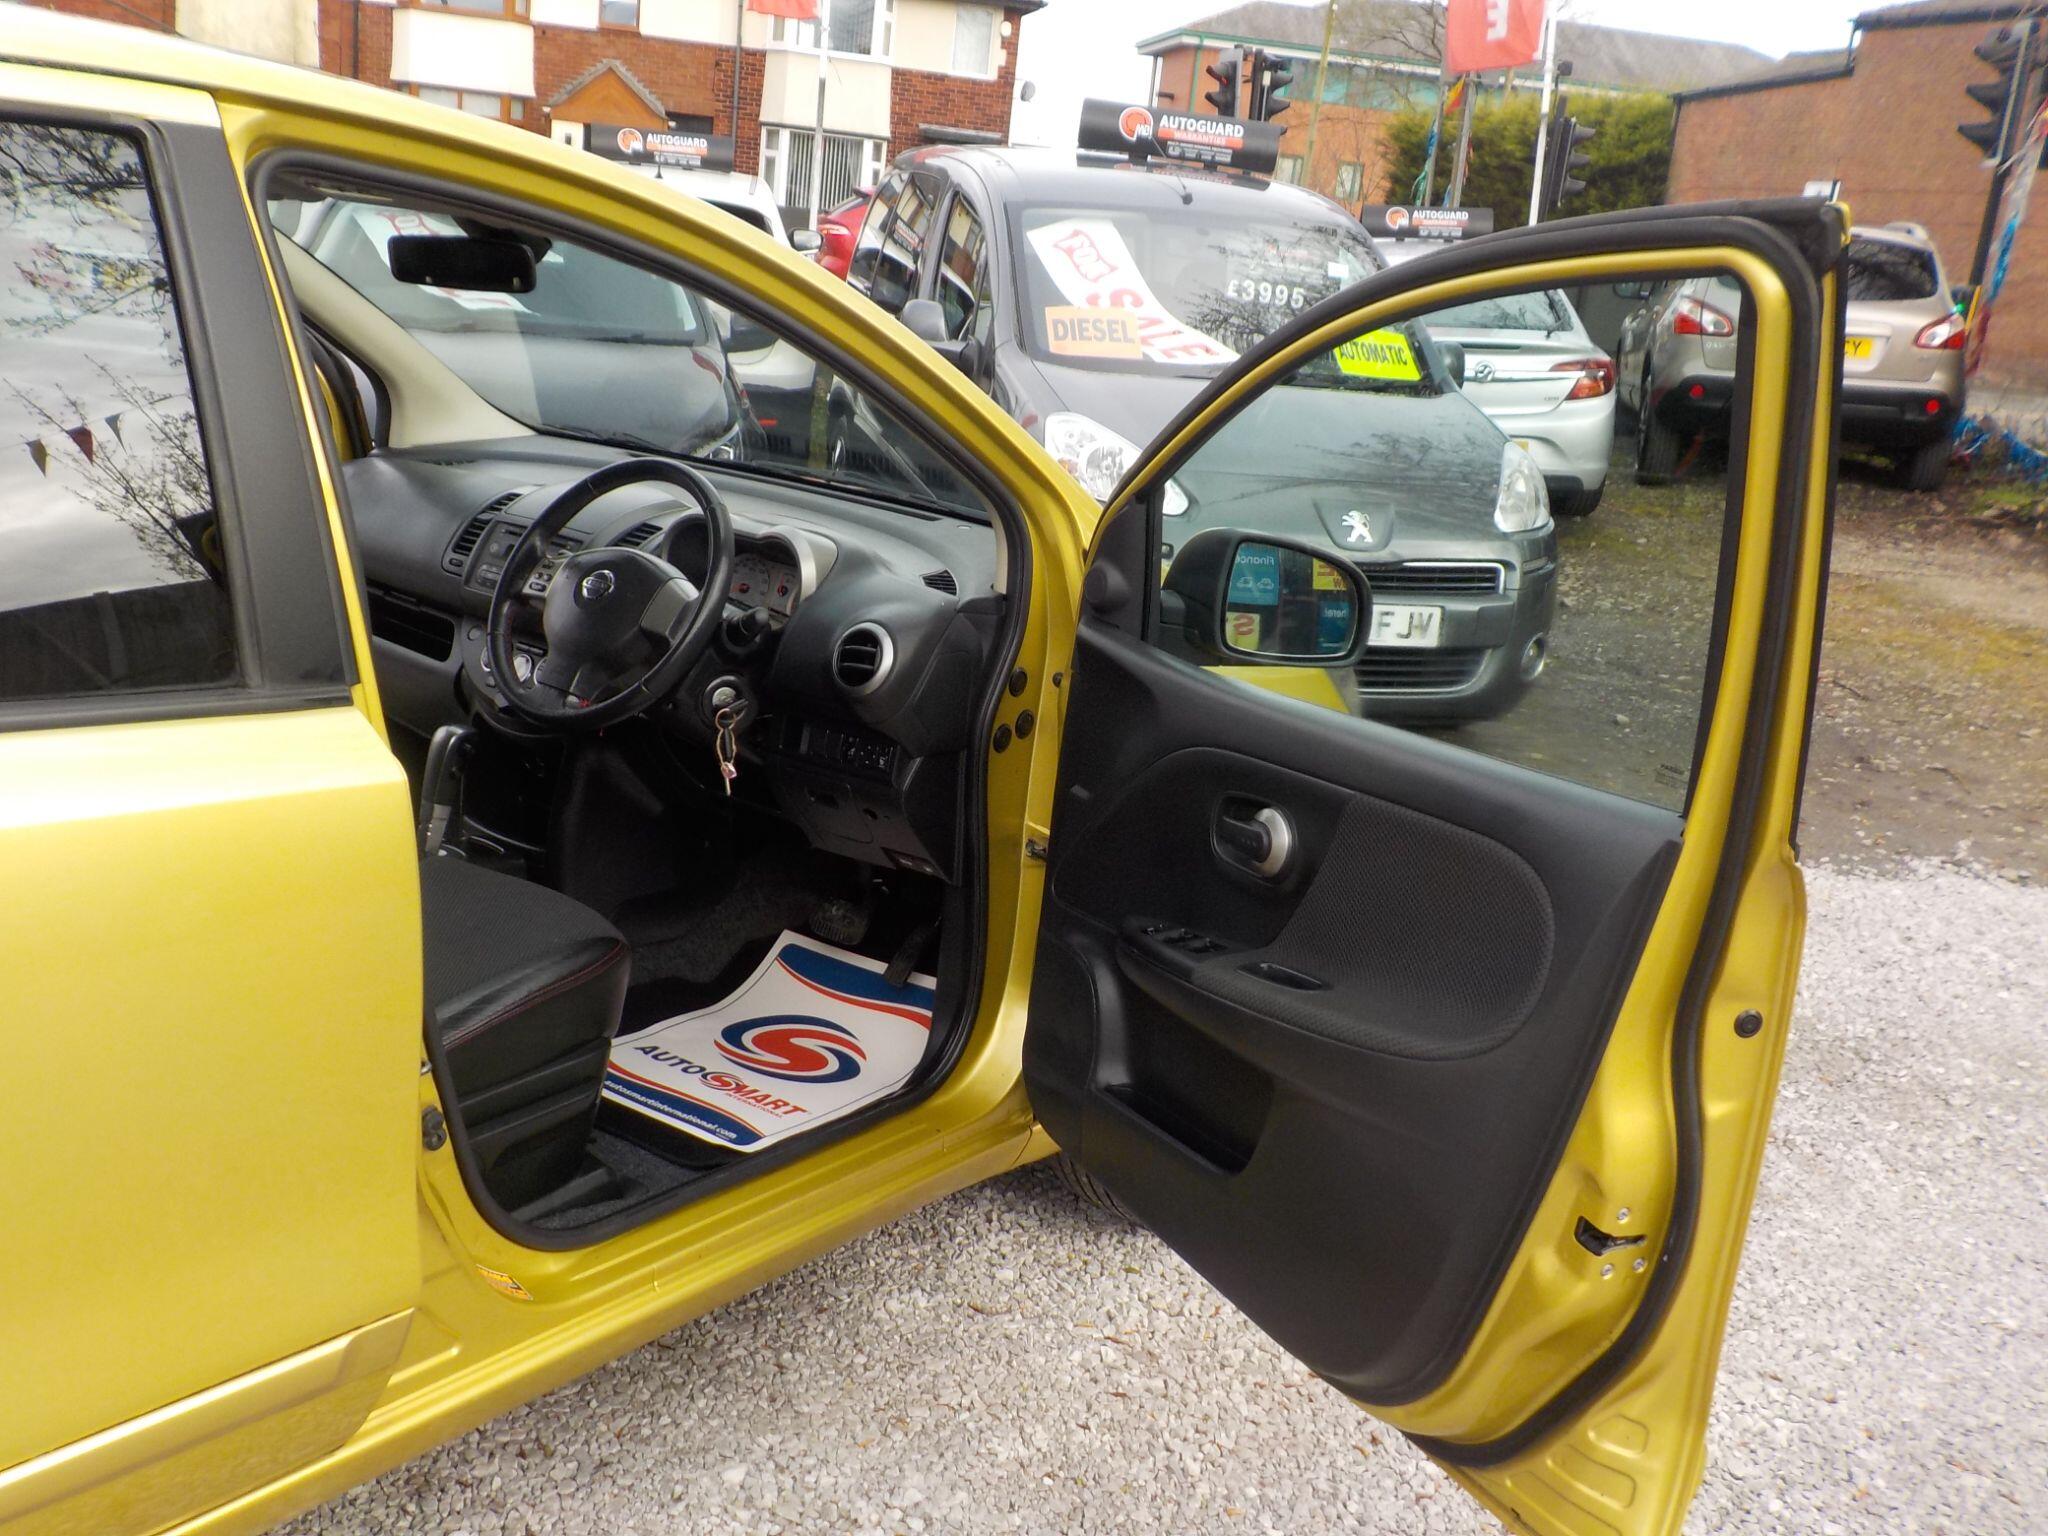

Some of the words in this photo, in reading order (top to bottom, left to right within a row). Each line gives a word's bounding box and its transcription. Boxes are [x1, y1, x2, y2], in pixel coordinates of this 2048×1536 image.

[1159, 114, 1245, 138] AUTOGUARD
[646, 132, 708, 148] AUTOGUARD
[1173, 131, 1227, 146] WARRANTIES
[1412, 209, 1469, 220] AUTOGUARD
[1227, 279, 1305, 309] £3995
[1052, 317, 1136, 344] DIESEL
[1340, 340, 1408, 366] AUTOMATIC
